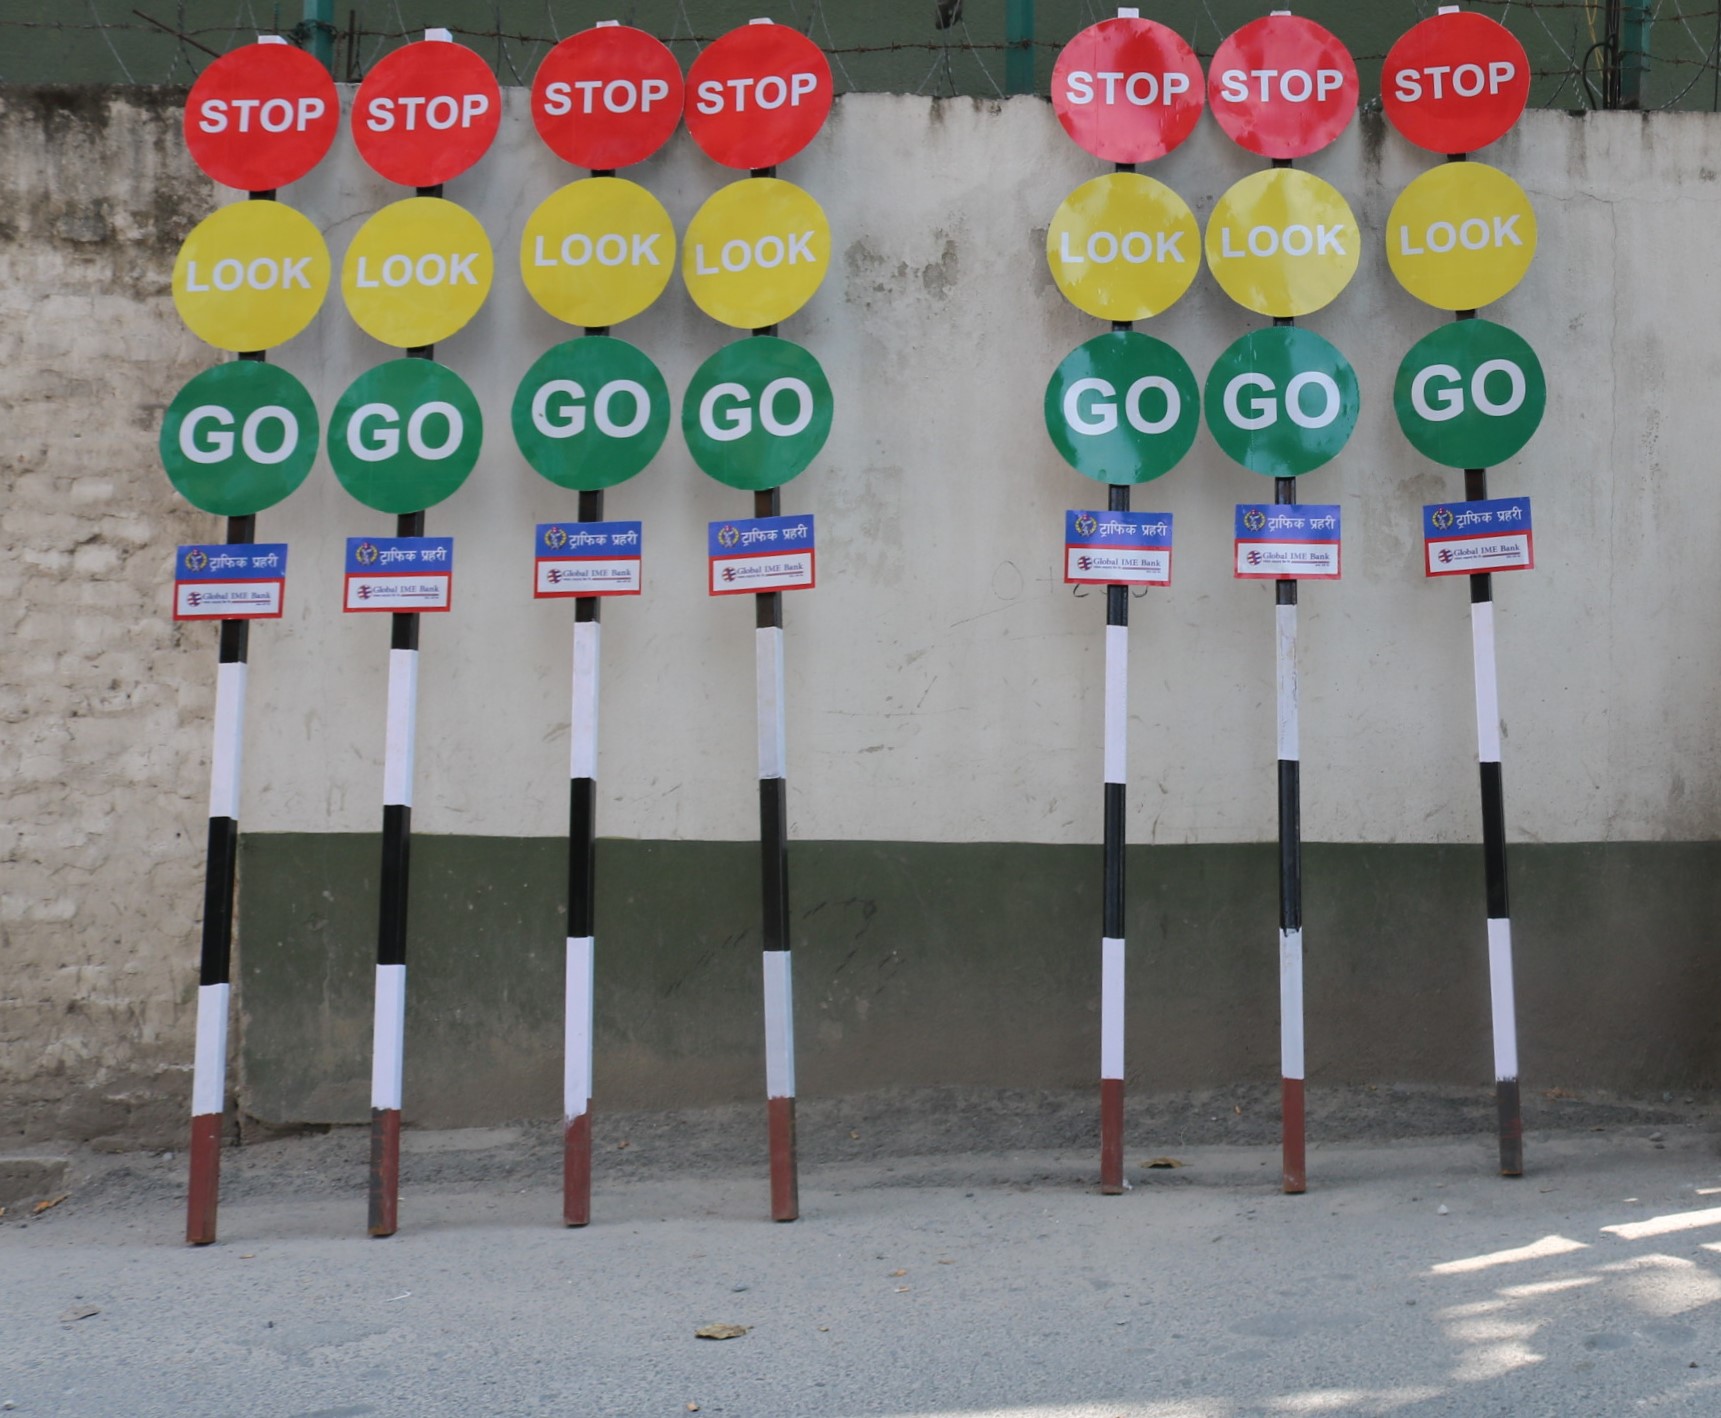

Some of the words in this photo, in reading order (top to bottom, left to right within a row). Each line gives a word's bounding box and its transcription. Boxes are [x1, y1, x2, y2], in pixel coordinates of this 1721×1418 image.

[543, 79, 669, 116] STOP
[697, 73, 817, 115] STOP
[1066, 71, 1190, 106] STOP
[1219, 69, 1343, 103] STOP
[1394, 61, 1516, 102] STOP
[199, 97, 325, 134] STOP
[367, 93, 488, 131] STOP
[534, 232, 660, 267] LOOK
[695, 230, 816, 275] LOOK
[1060, 230, 1186, 264] LOOK
[1221, 224, 1345, 257] LOOK
[1400, 214, 1522, 256] LOOK
[185, 257, 313, 292] LOOK
[356, 253, 478, 288] LOOK
[1064, 376, 1180, 435] GO
[1223, 371, 1340, 430] GO
[1410, 359, 1525, 421] GO
[532, 379, 650, 438] GO
[699, 376, 813, 441] GO
[179, 404, 298, 464] GO
[346, 401, 464, 461] GO
[741, 528, 778, 546] ट्राफिक
[782, 524, 808, 540] प्रहरी
[1099, 520, 1137, 537] ट्राफिक
[1142, 522, 1167, 536] प्रहरी
[1268, 515, 1305, 531] ट्राफिक
[1309, 515, 1335, 529] प्रहरी
[1456, 510, 1492, 529] ट्राफिक
[1497, 506, 1522, 522] प्रहरी
[379, 547, 416, 565] ट्राफिक
[421, 547, 447, 562] प्रहरी
[569, 531, 607, 549] ट्राफिक
[612, 530, 637, 545] प्रहरी
[1454, 548, 1478, 556] Global
[1481, 546, 1498, 554] IME
[1501, 544, 1520, 552] Bank
[209, 554, 248, 572] ट्राफिक
[252, 553, 278, 568] प्रहरी
[737, 566, 761, 574] Global
[784, 563, 803, 571] Bank
